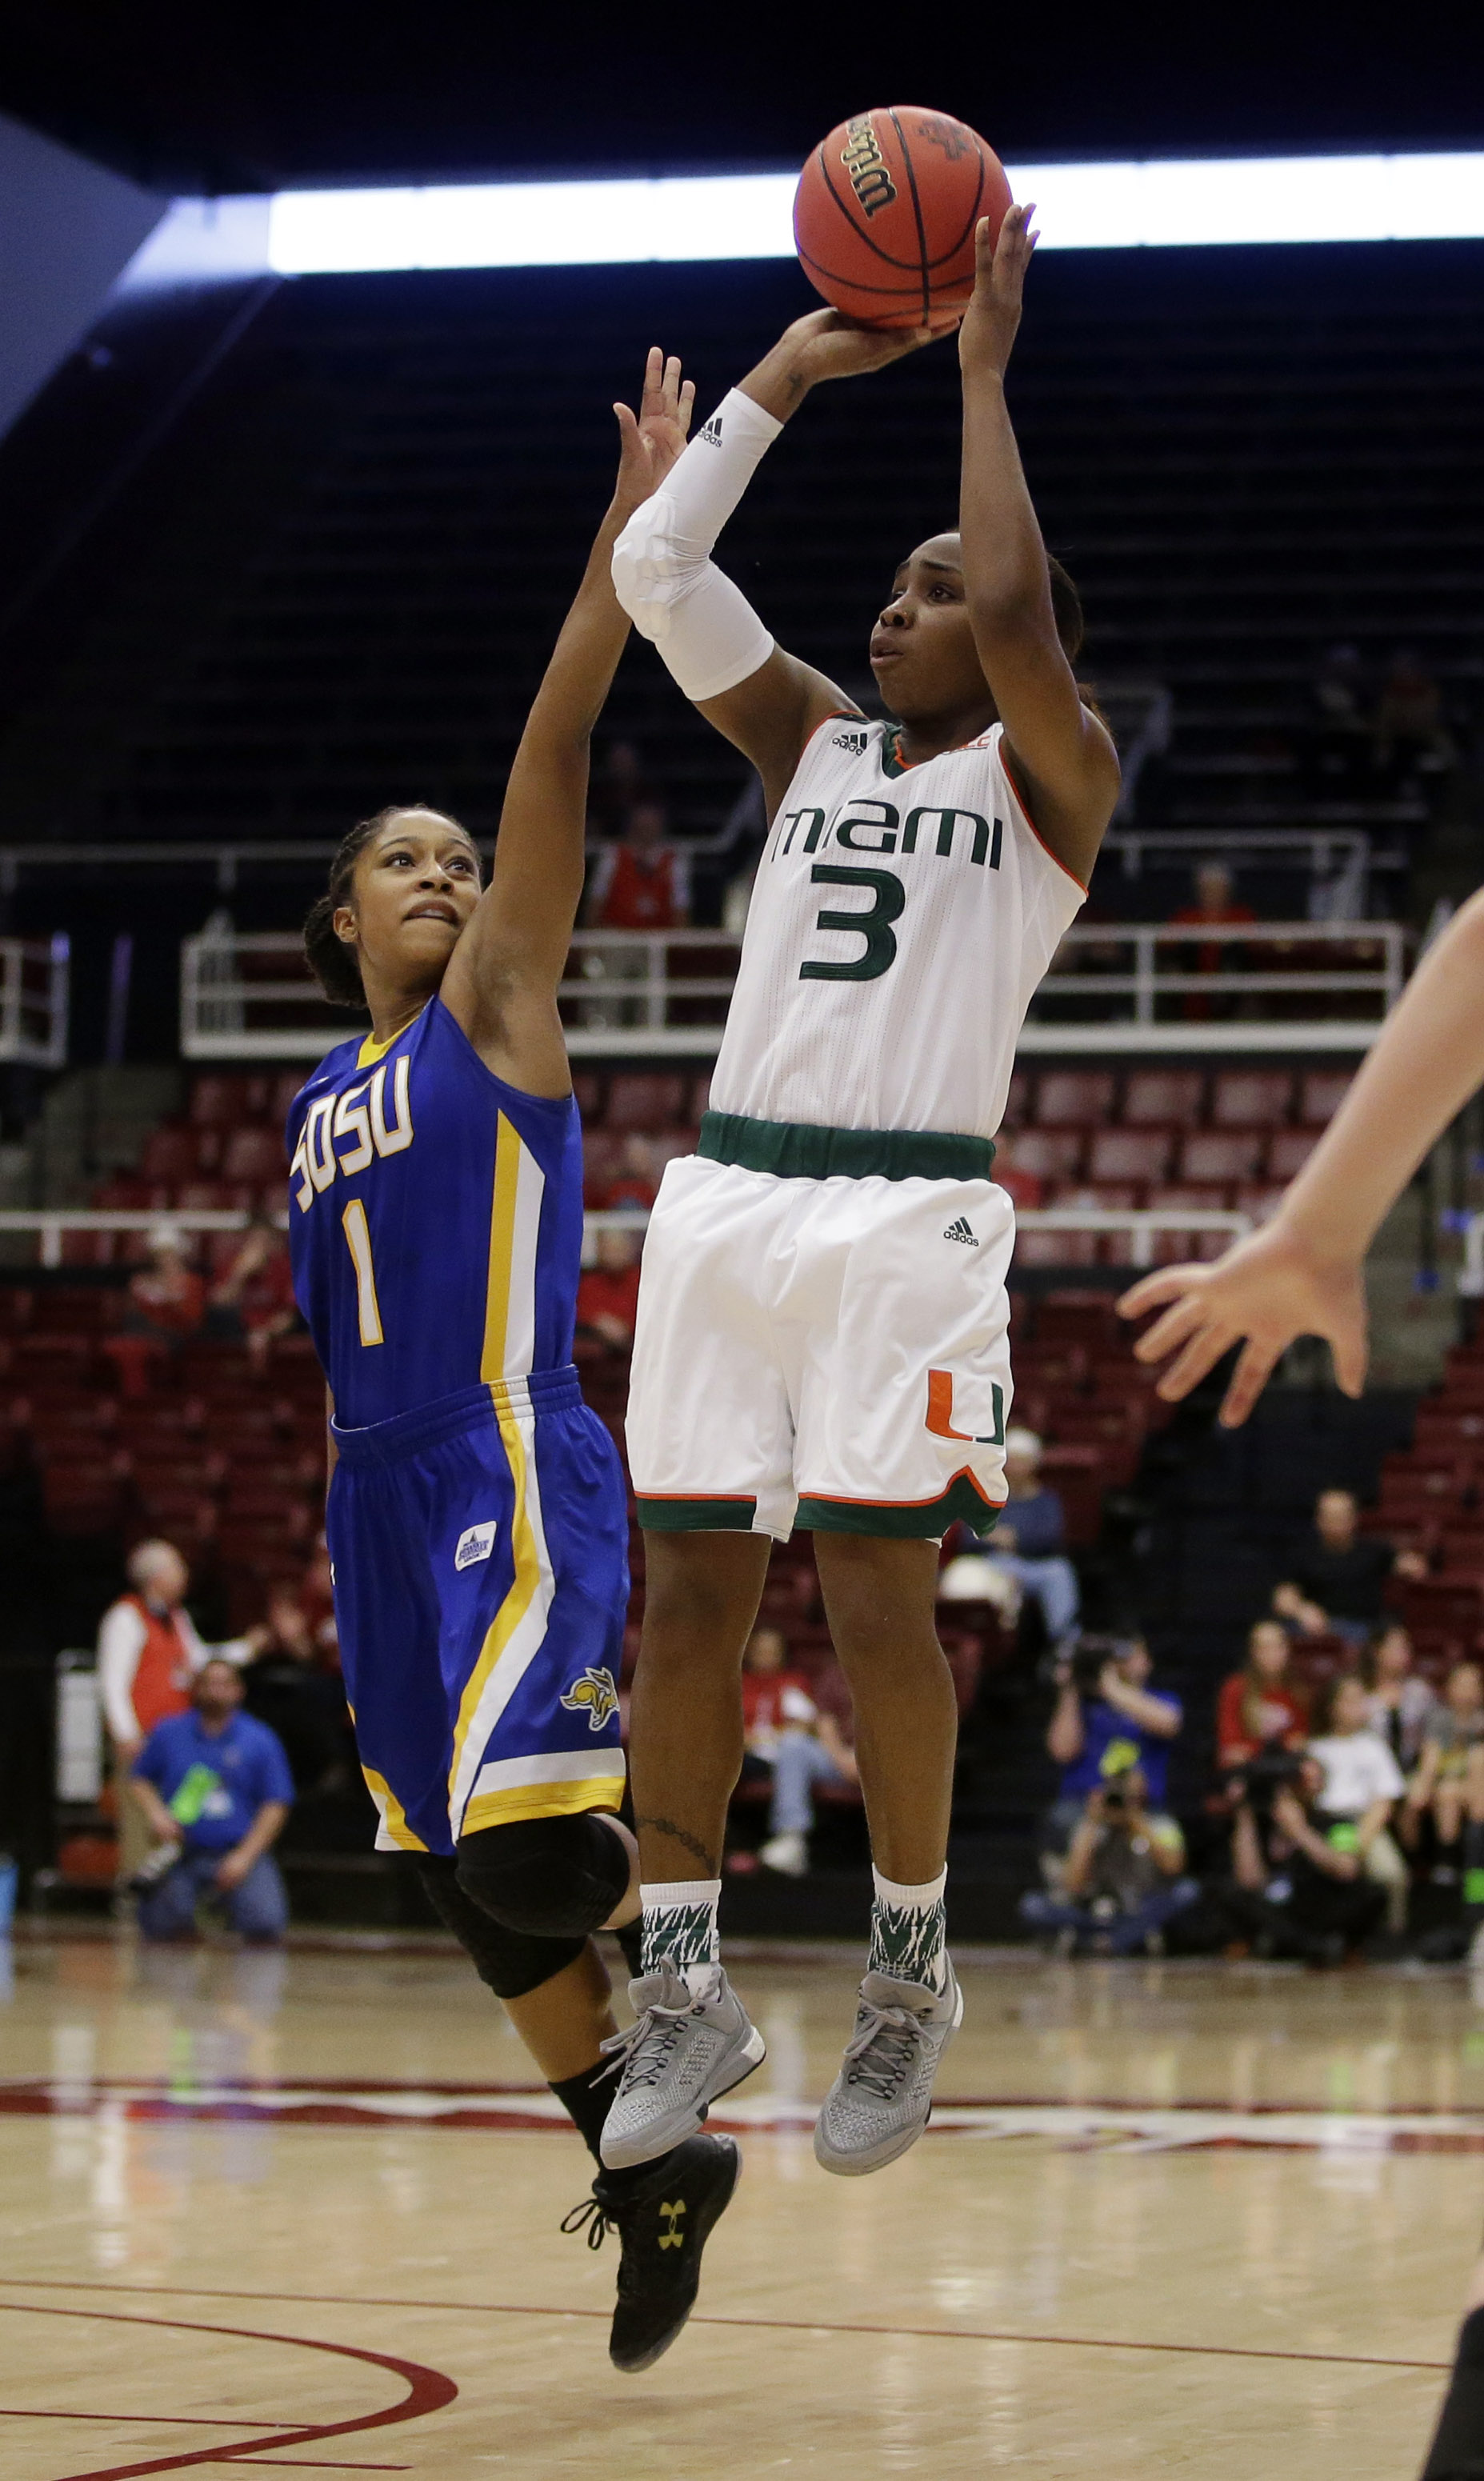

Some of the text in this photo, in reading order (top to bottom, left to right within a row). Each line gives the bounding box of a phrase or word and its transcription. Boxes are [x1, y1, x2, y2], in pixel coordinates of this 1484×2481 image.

[798, 863, 906, 981] 3
[342, 1198, 384, 1347] 1
[943, 1230, 979, 1247] adidas
